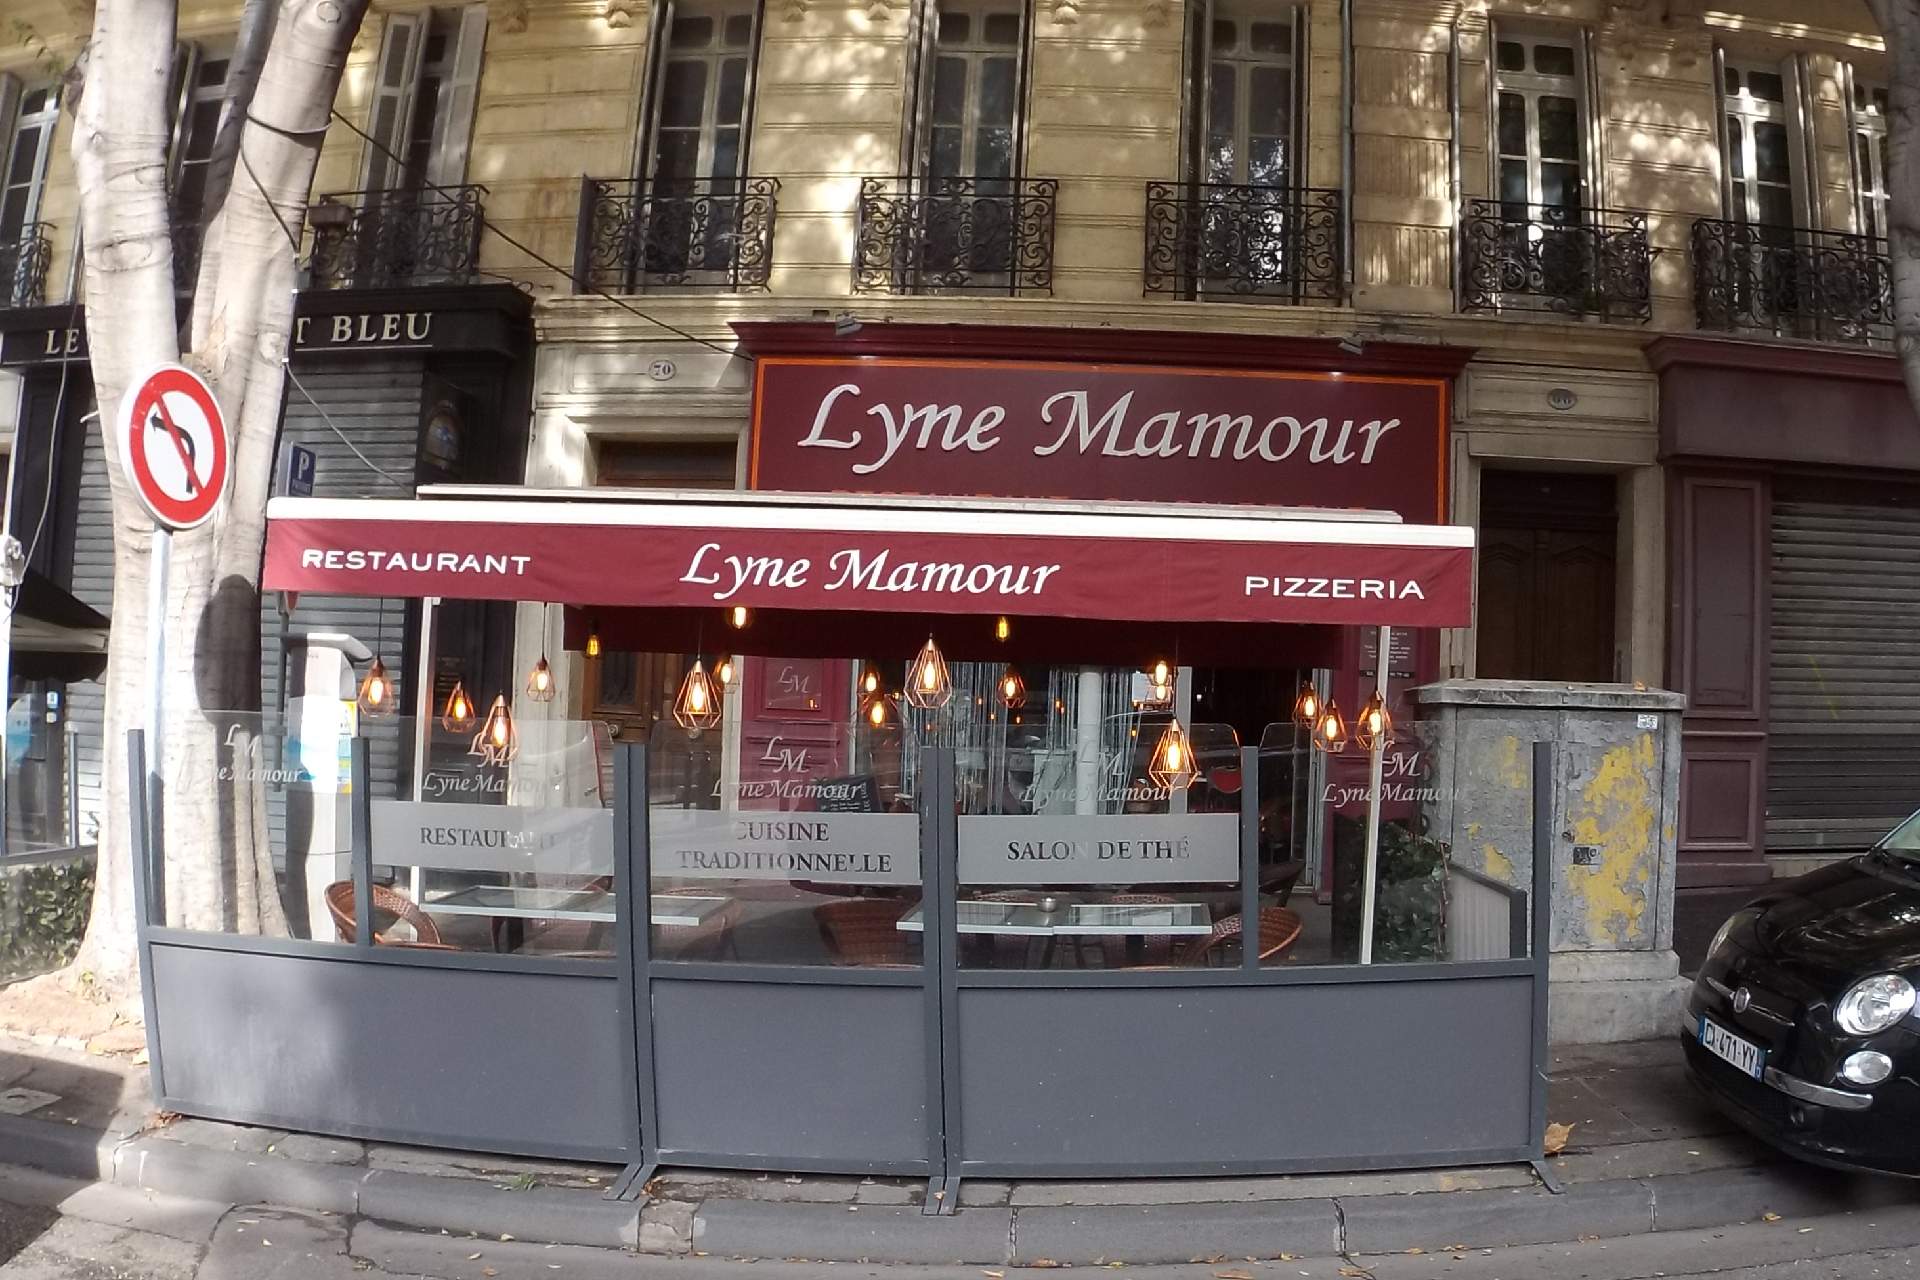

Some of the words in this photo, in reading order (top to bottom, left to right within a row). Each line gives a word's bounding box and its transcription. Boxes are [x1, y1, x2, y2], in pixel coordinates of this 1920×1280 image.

[45, 328, 79, 355] LE
[330, 311, 434, 343] BLEU
[653, 363, 672, 376] 70
[797, 382, 1005, 475] Lyne
[1032, 388, 1402, 466] Mamour
[301, 548, 532, 577] RESTAURANT
[678, 542, 811, 600] Lyne
[822, 548, 1062, 597] Mamour
[1243, 575, 1428, 601] PIZZERIA
[422, 772, 470, 797] Lyne
[1096, 840, 1133, 861] DE
[1137, 835, 1190, 861] THÉ
[675, 849, 893, 875] TRADITIONNELLE
